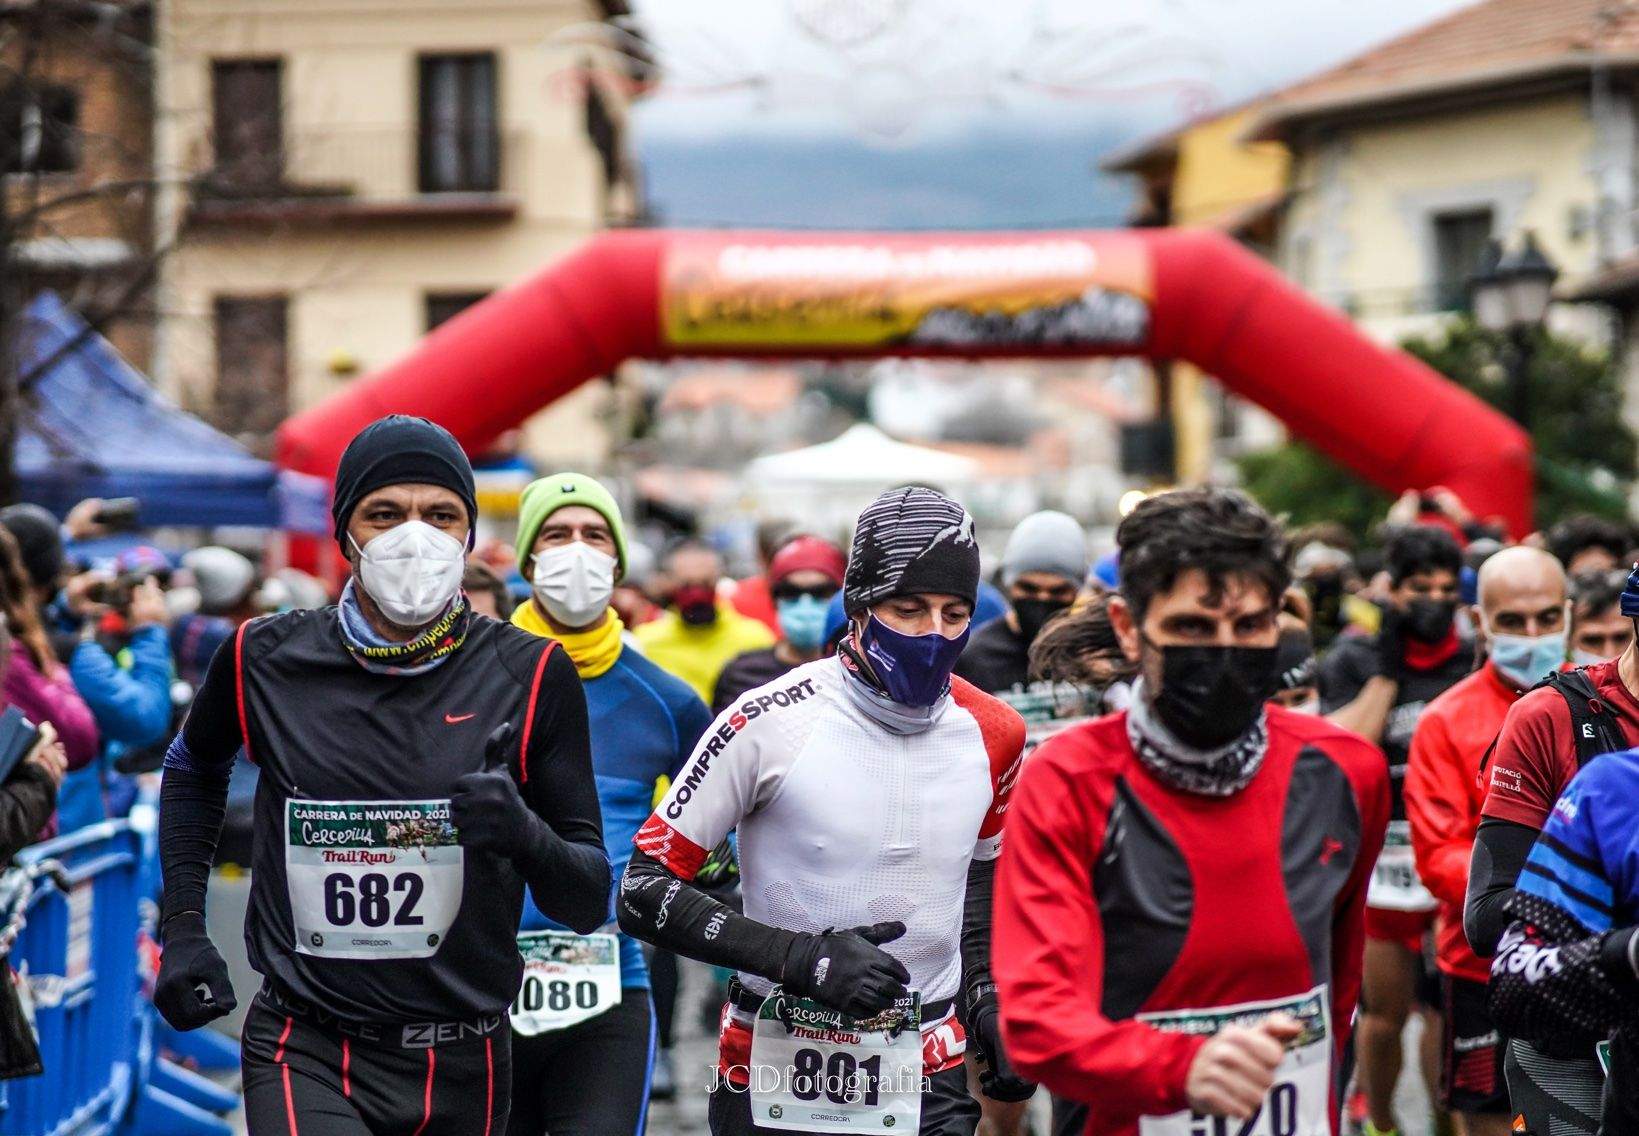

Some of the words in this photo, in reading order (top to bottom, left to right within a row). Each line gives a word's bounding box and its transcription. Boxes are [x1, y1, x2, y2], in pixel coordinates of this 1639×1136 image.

[666, 678, 816, 819] COMPRESSPORT
[294, 809, 347, 820] CARRERA
[366, 810, 421, 820] NAVIDAD
[426, 809, 450, 820] 2021
[322, 850, 357, 863] Trail
[359, 851, 396, 865] Run
[324, 872, 424, 927] 682
[793, 1026, 826, 1040] Trail
[828, 1029, 861, 1045] Run
[792, 1048, 881, 1106] 801
